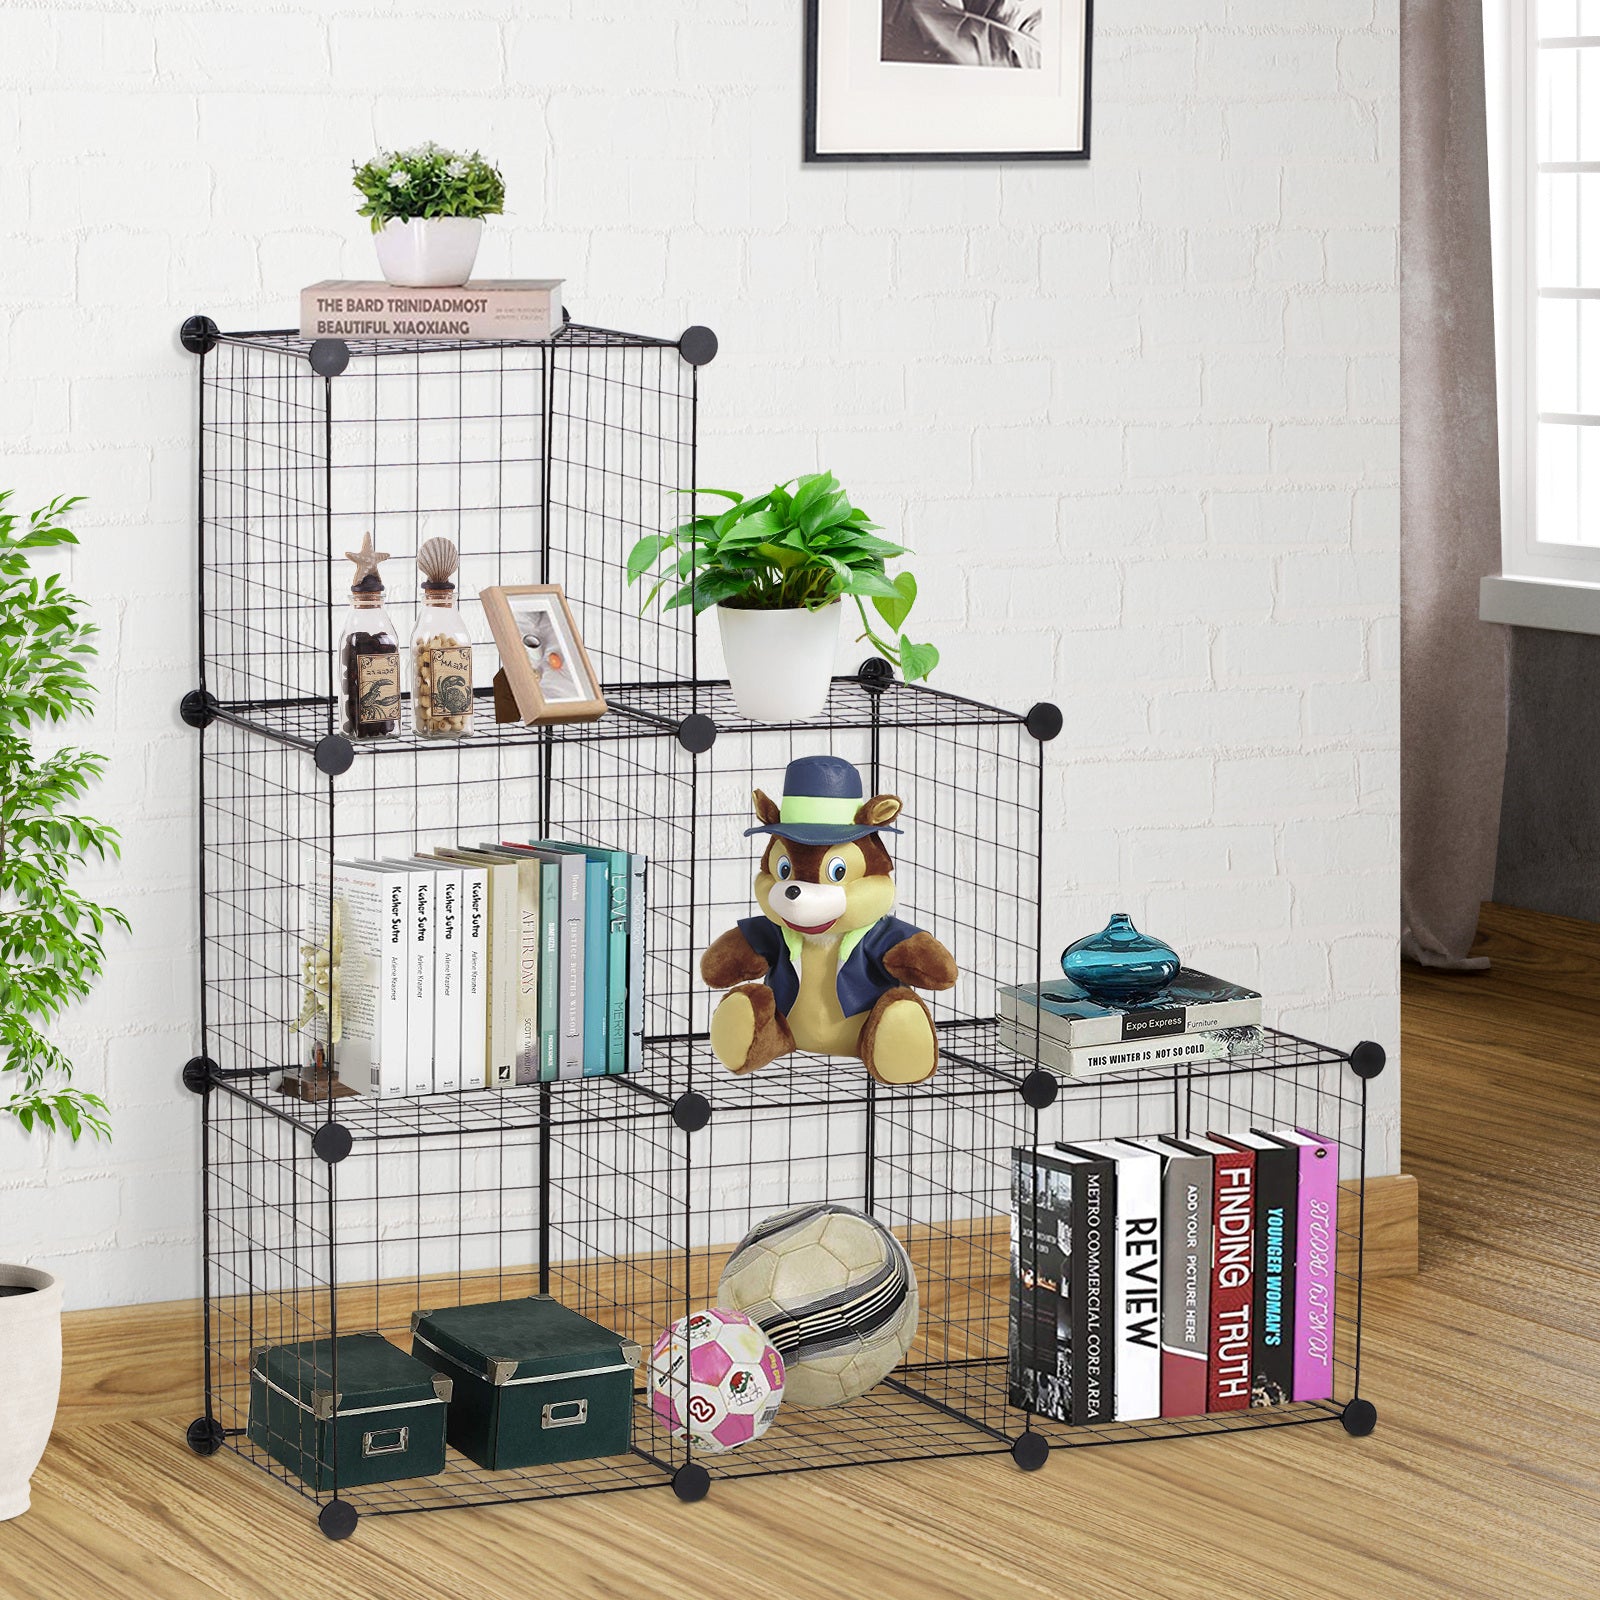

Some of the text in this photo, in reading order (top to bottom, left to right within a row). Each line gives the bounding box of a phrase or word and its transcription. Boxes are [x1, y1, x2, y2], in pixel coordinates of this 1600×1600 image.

[317, 298, 487, 313] THE BARD TRINIDADMOST
[317, 320, 470, 335] BEAUTIFUL XIAOXIANG
[392, 886, 401, 943] Kosher Sutra
[418, 885, 428, 942] Kosher Sutra
[445, 883, 455, 940] Kosher Sutra
[472, 882, 481, 938] Kosher Sutra
[611, 874, 627, 933] LOVE
[521, 910, 535, 995] AFTER DAYS
[613, 1002, 624, 1056] MERRITT
[1125, 1016, 1182, 1032] Expo Express
[1187, 1018, 1218, 1029] Furniture
[1088, 1043, 1205, 1067] THIS WINTER IS NOT SO COLD
[1125, 1217, 1158, 1349] REVIEW
[1185, 1184, 1198, 1343] ADD YOUR PICTURE HERE
[1218, 1167, 1251, 1398] FINDING TRUTH
[1265, 1207, 1283, 1346] YOUNGER WOMAN'S
[1308, 1198, 1329, 1366] LONELY PEOPLE
[1086, 1173, 1101, 1419] METRO COMMERCIAL CORE AREA
[691, 1397, 715, 1422] 2
